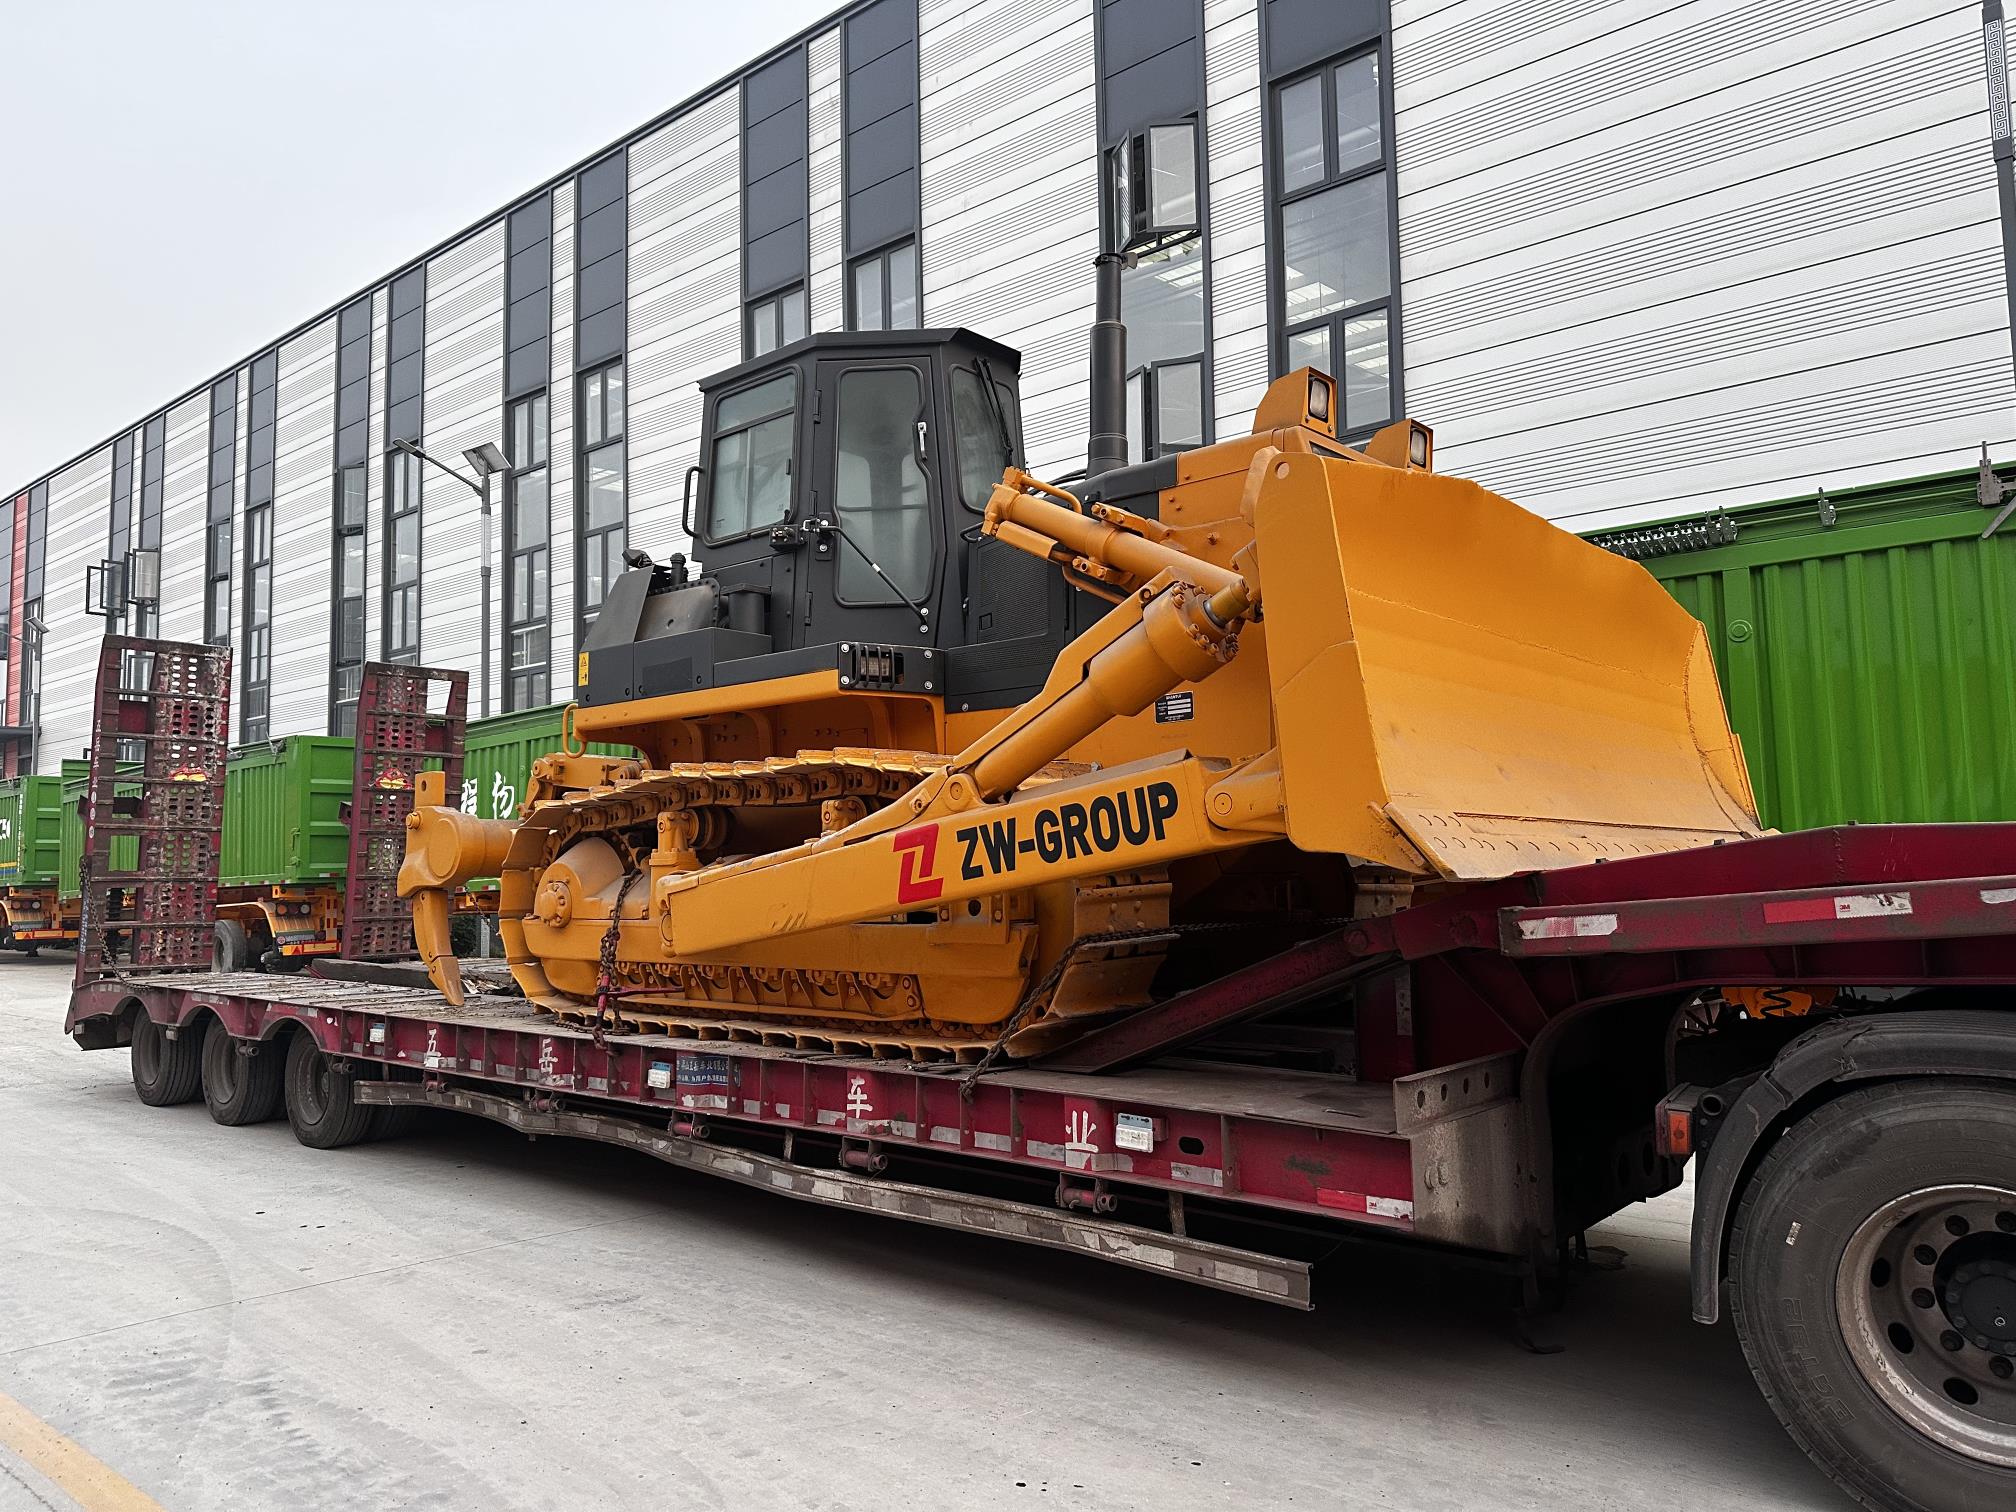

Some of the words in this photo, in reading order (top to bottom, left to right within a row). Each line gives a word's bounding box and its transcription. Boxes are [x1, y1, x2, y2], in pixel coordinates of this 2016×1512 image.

[956, 781, 1179, 881] ZW-GROUP
[846, 1074, 873, 1118] 车
[1065, 1110, 1099, 1153] 业
